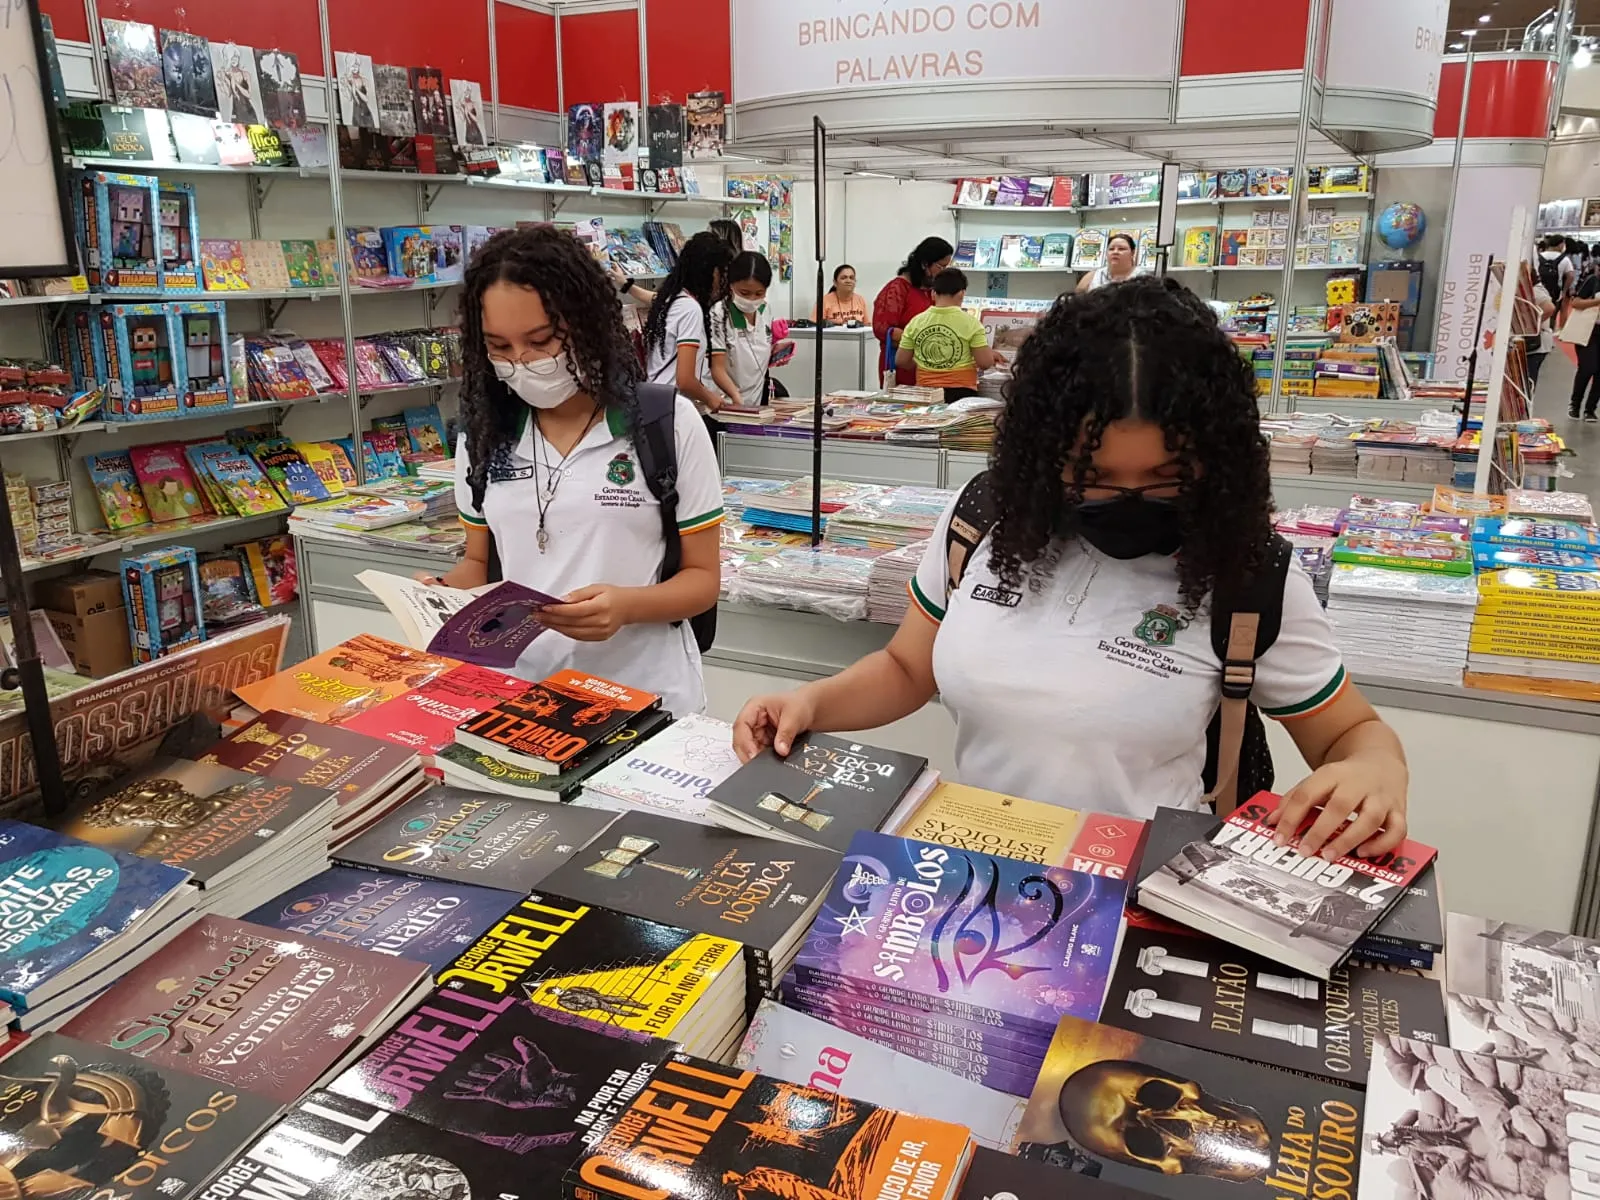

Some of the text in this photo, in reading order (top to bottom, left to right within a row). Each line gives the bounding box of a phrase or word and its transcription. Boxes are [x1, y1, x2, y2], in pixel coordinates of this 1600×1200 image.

[798, 1, 1039, 47] BRINCANDO COM
[836, 50, 984, 84] PALAVRAS
[1434, 281, 1456, 366] PALAVRAS
[1459, 254, 1483, 351] BRINCANDO
[594, 494, 619, 502] ESTADO
[602, 487, 633, 496] GOVERNO
[1098, 640, 1183, 675] ESTADO DO CEARÁ
[1105, 654, 1135, 668] Secretaria
[1114, 636, 1175, 665] GOVERNO DO
[76, 658, 199, 706] PRANCHETA PARA COLORIR
[467, 708, 588, 761] ORWELL
[515, 738, 549, 758] GEORGE
[508, 769, 541, 783] Lewis
[803, 757, 870, 784] CELTA
[158, 824, 210, 857] MARCO
[164, 784, 294, 867] MEDITAÇÕES
[383, 799, 488, 865] Sherlock
[437, 801, 512, 853] Holmes
[470, 812, 551, 871] Baskerville
[484, 832, 508, 849] cão
[925, 818, 1047, 855] ESTOICAS
[1229, 816, 1255, 830] EM
[1210, 823, 1353, 889] GUERRA
[287, 878, 393, 936] herlock
[698, 861, 756, 906] CELTA
[720, 860, 797, 924] NÓRDICA
[318, 881, 422, 943] Holmes
[369, 896, 462, 957] uatro
[376, 918, 407, 938] signo
[438, 901, 591, 993] ORWELL
[455, 935, 501, 970] GEORGE
[1062, 923, 1080, 968] CLAUDIO BLANC
[110, 937, 262, 1058] Sherlock
[176, 949, 287, 1037] Holme
[647, 1002, 672, 1031] FLOR
[666, 991, 684, 1013] DA
[678, 942, 730, 1006] INGLATERRA
[1210, 962, 1249, 1036] PLATÃO
[1366, 988, 1380, 1004] DE
[209, 1032, 240, 1056] Um
[239, 985, 289, 1031] estudo
[380, 989, 517, 1111] ORWELL
[1325, 1048, 1353, 1073] O
[574, 1068, 631, 1127] NA PIOR EM
[1286, 1105, 1306, 1129] DO
[579, 1061, 757, 1200] ORWELL
[890, 1157, 917, 1176] DE
[906, 1160, 943, 1200] FAVOR
[1265, 1132, 1314, 1198] ILHA
